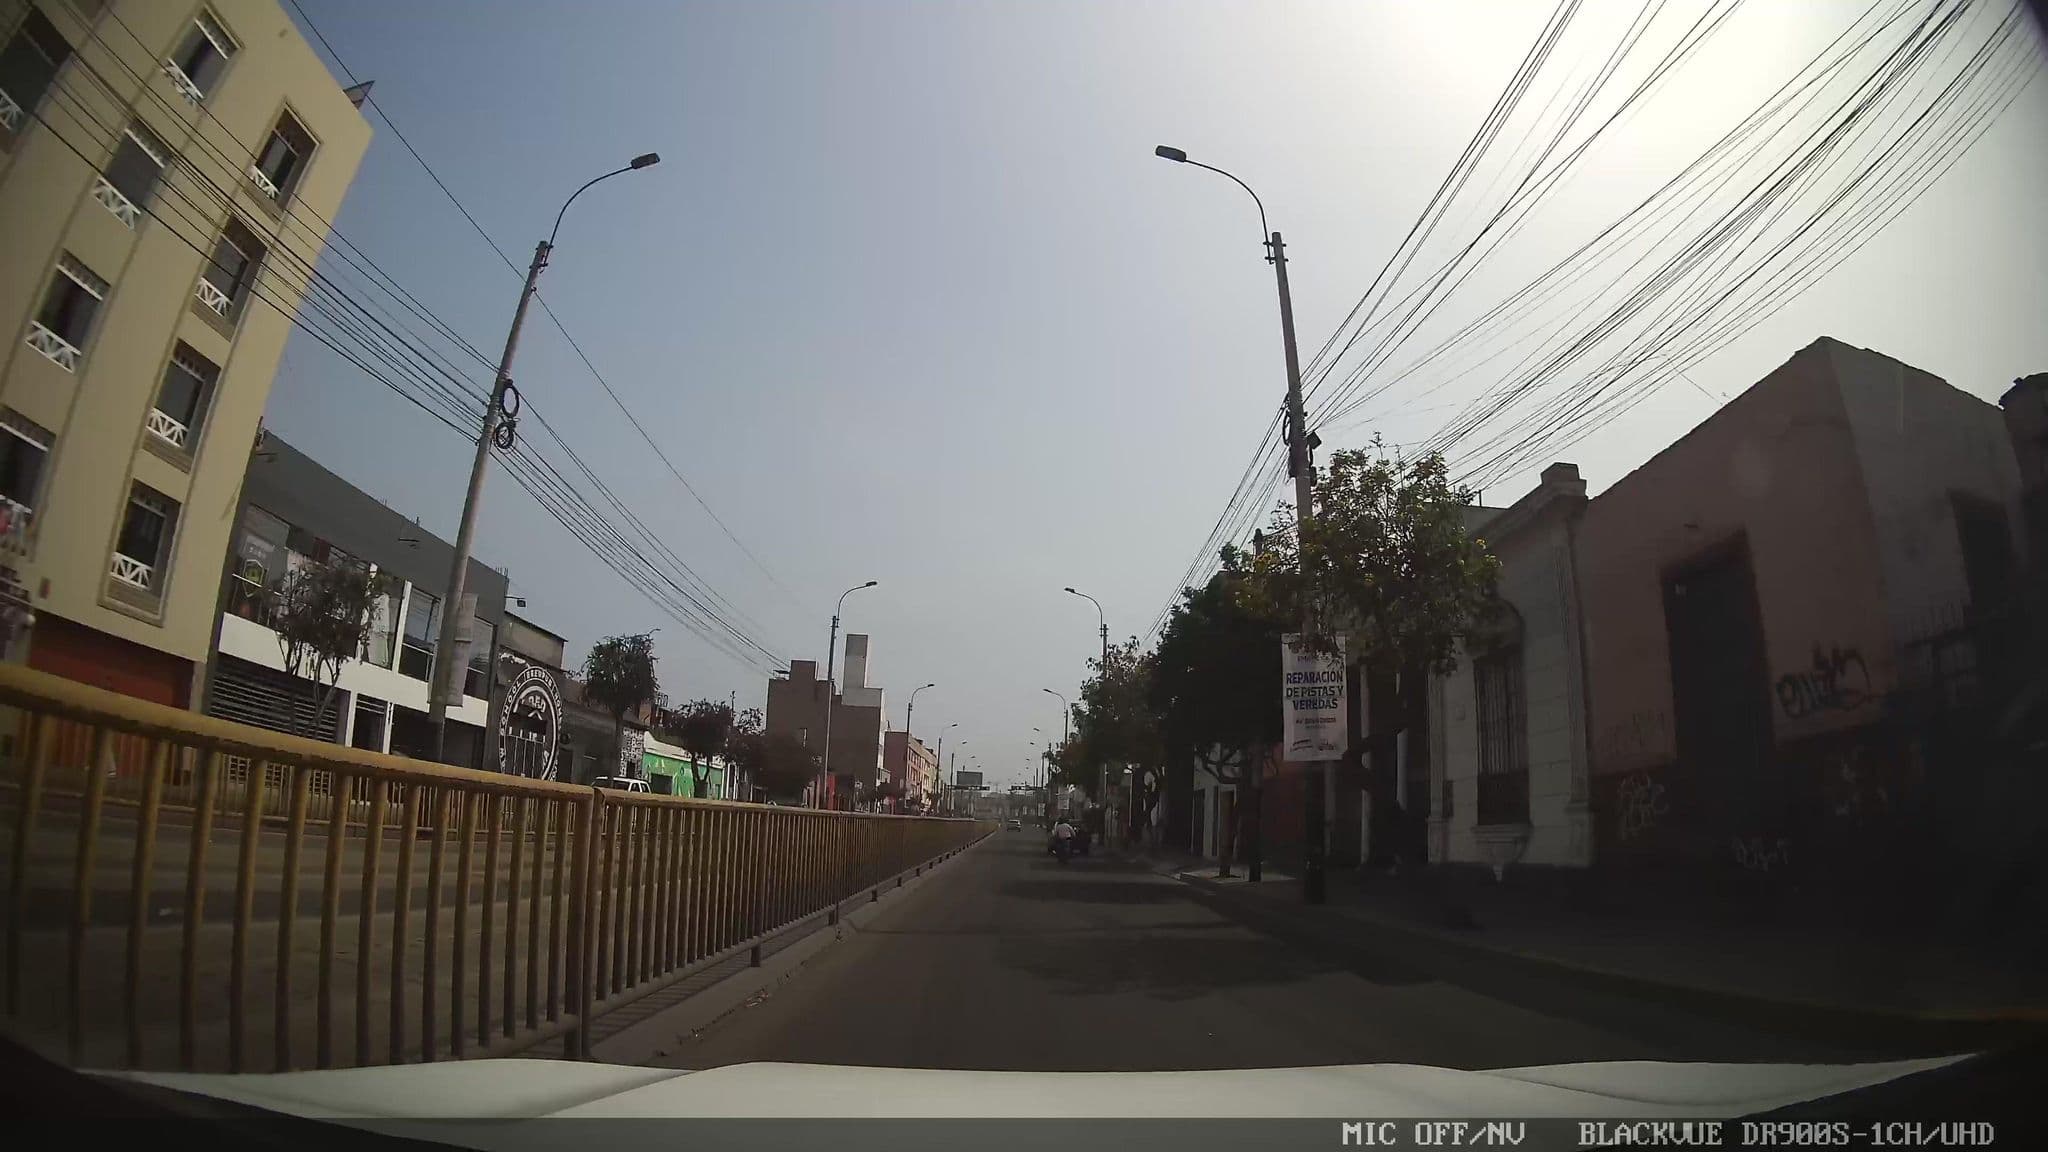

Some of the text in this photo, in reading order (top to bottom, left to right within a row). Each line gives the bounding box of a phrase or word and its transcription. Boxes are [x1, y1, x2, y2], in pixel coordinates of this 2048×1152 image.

[1286, 685, 1344, 698] DE PISTAS Y
[1292, 698, 1338, 710] VEREDAS
